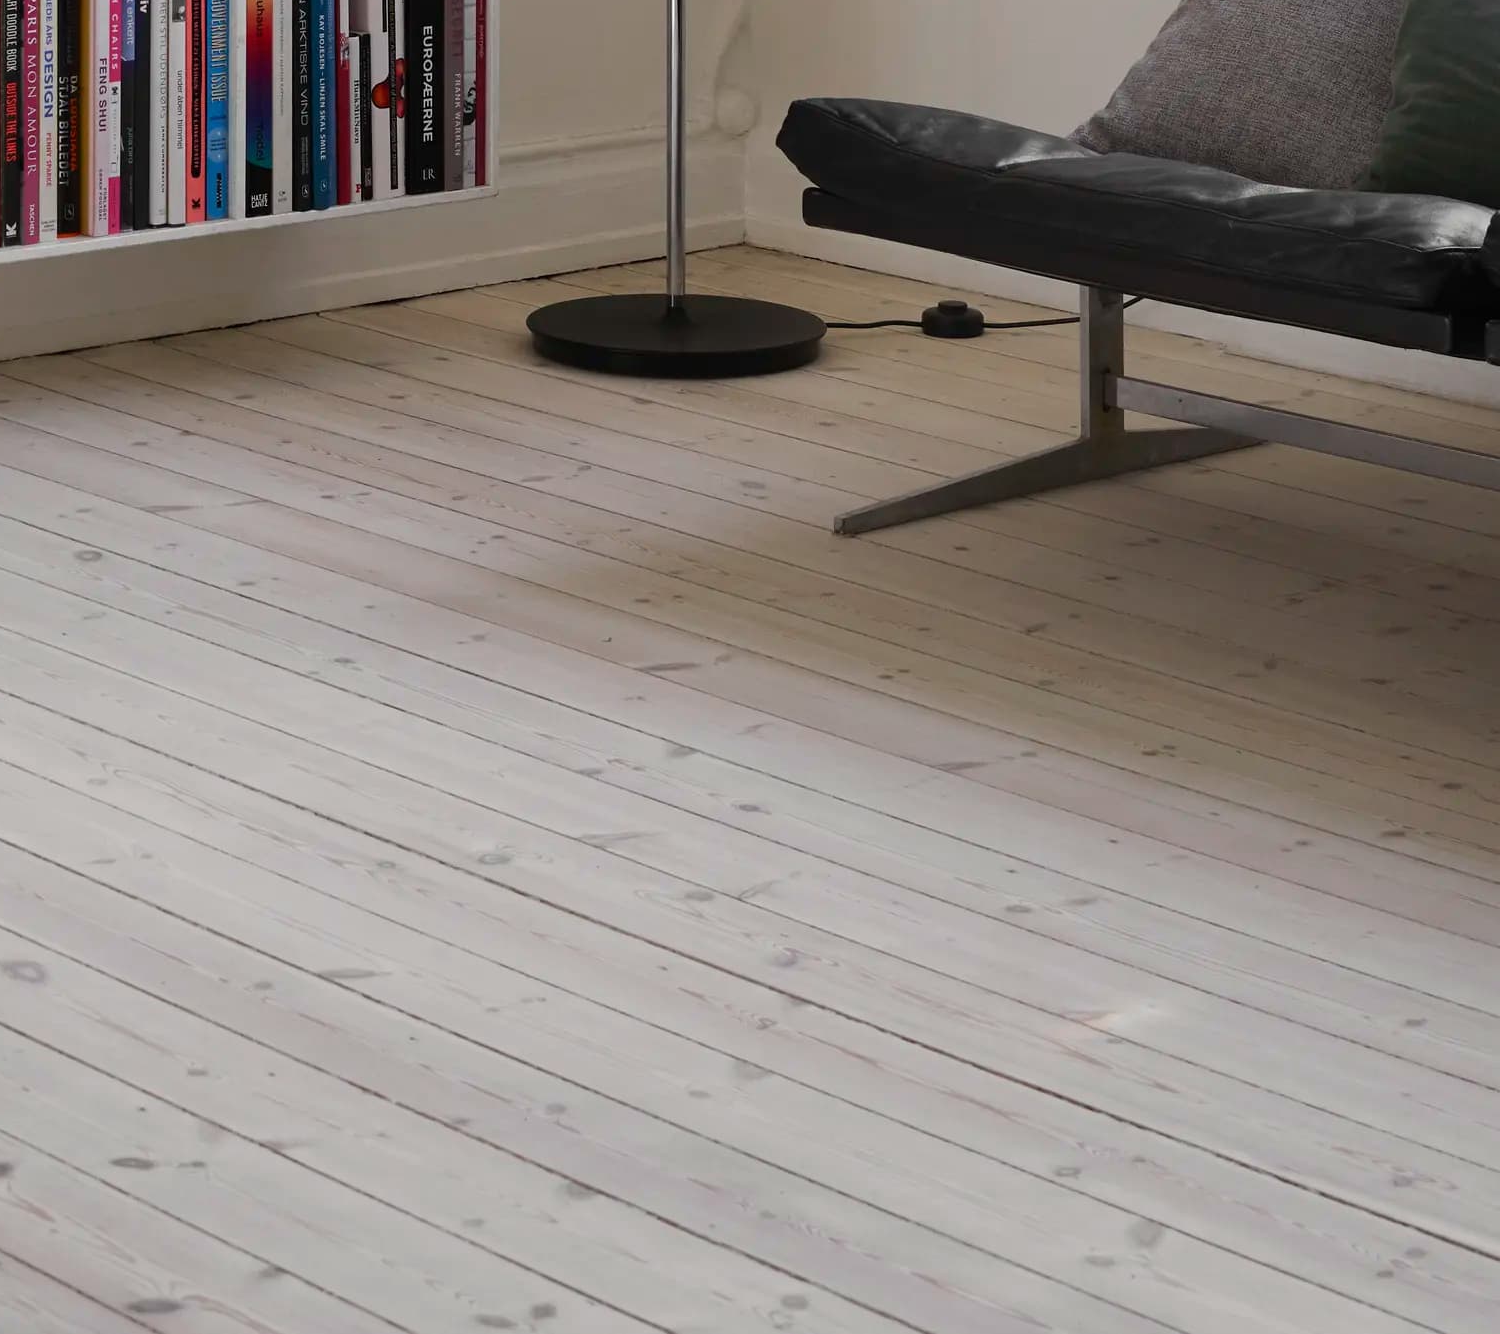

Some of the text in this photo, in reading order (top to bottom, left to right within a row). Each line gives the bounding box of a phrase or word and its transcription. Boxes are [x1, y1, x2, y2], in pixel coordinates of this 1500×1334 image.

[7, 14, 17, 46] DOODLE
[299, 9, 307, 84] ARKTISKE
[7, 49, 17, 71] BOOK
[28, 54, 37, 100] MON
[99, 58, 107, 132] FENG SHUI
[211, 73, 228, 102] ISSUE
[300, 89, 308, 125] VIND
[423, 26, 433, 142] EUROPÆERNE
[27, 106, 37, 175] AMOUR
